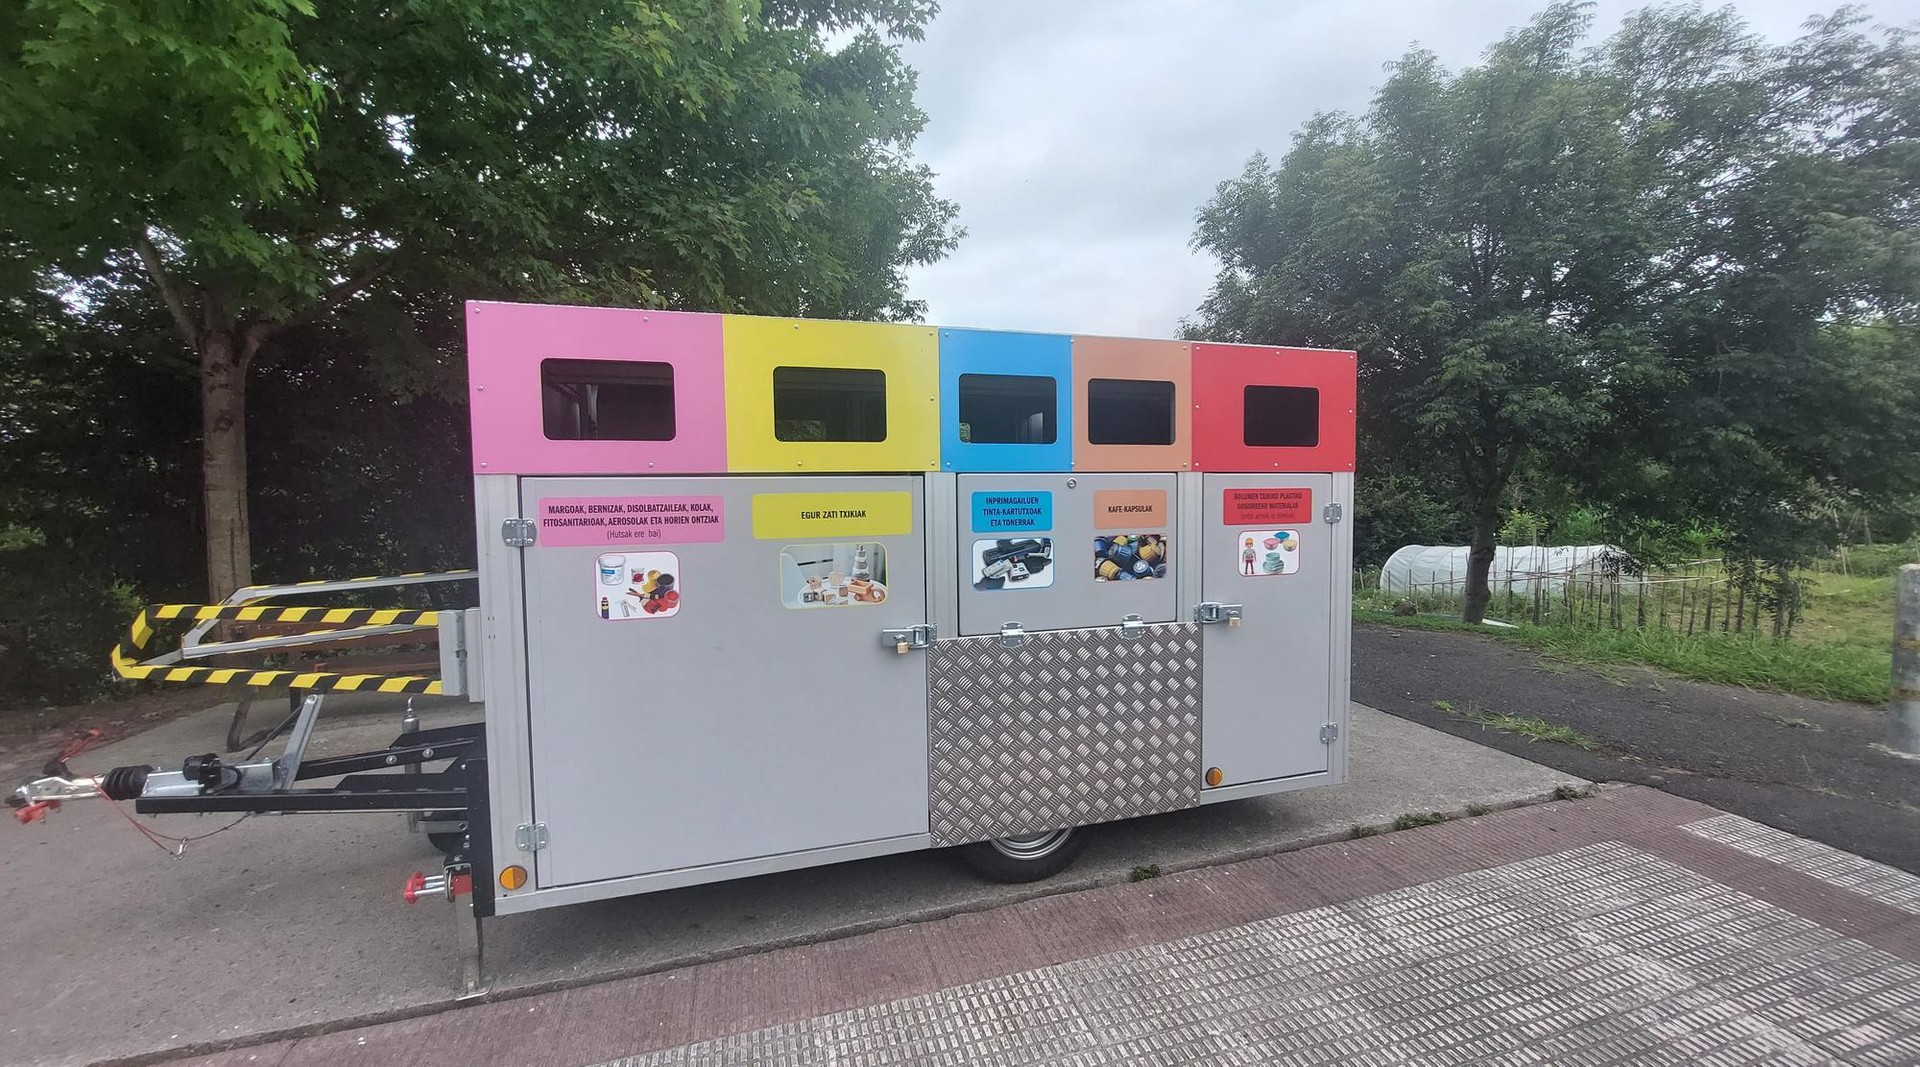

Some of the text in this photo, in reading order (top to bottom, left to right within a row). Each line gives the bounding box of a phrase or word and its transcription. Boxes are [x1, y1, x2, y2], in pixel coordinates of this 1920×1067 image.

[548, 503, 714, 515] MARGOAK, BERNIZAK, DISOLBATZAILEAK, KOLAK,
[983, 508, 1042, 516] TINTA-KARTUTXOAK
[1108, 505, 1153, 513] KAFE-KAPSULAK
[801, 510, 867, 519] EGUR ZATI TXIKIAK
[543, 515, 719, 527] FITOSANITARIOAK, AEROSOLAK ETA HORIEN ONTZIAK
[990, 518, 1035, 526] ETA TONERRAK
[606, 530, 632, 540] (Hutsak
[648, 529, 661, 538] bai)
